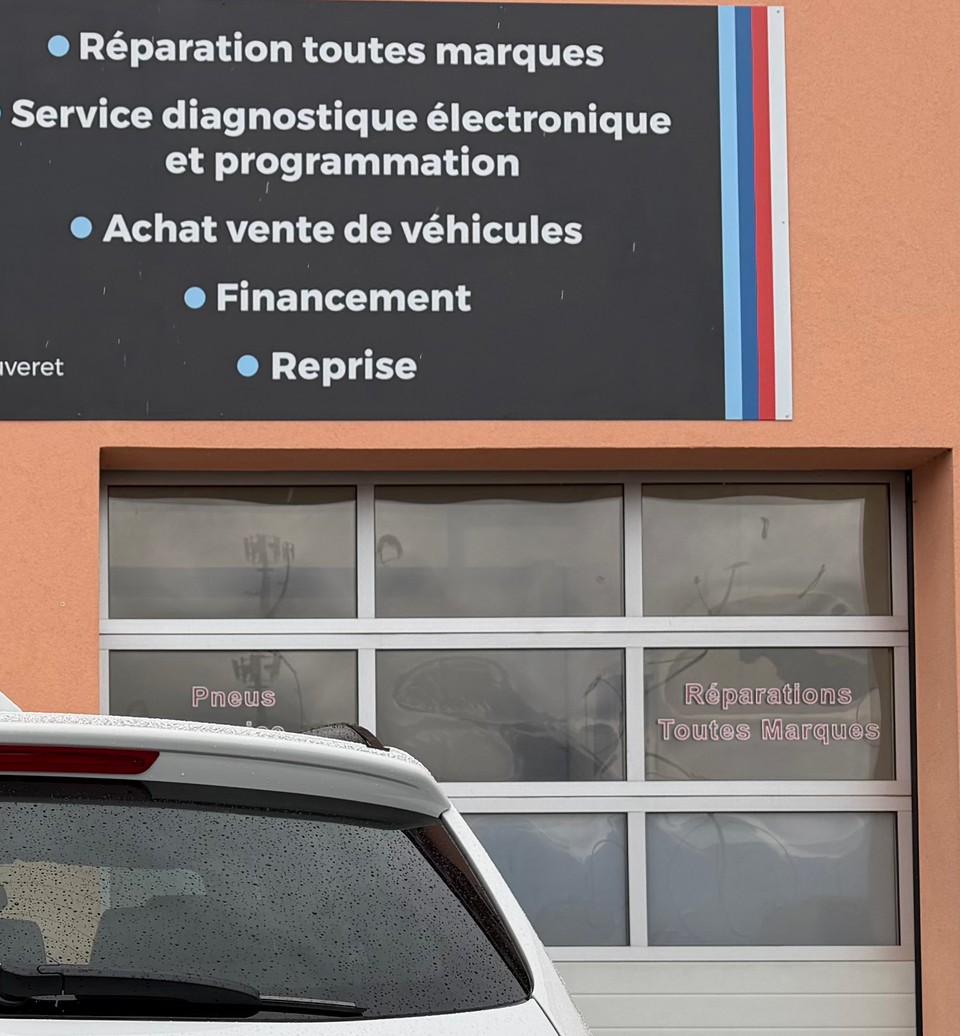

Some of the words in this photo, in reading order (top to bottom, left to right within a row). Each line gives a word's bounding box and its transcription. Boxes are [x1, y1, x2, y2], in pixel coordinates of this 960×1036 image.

[79, 30, 293, 68] Réparation
[302, 36, 426, 65] toutes
[436, 42, 604, 73] marques
[11, 96, 153, 129] Service
[161, 97, 418, 136] diagnostique
[426, 101, 672, 141] électronique
[165, 147, 205, 175] et
[215, 144, 520, 183] programmation
[102, 212, 218, 243] Achat
[225, 216, 335, 244] vente
[343, 213, 393, 244] de
[400, 212, 583, 245] véhicules
[217, 279, 472, 312] Financement
[272, 348, 418, 387] Reprise
[191, 685, 277, 708] Pneus
[684, 682, 853, 710] Réparations
[657, 718, 751, 741] Toutes
[761, 718, 881, 745] Marques
